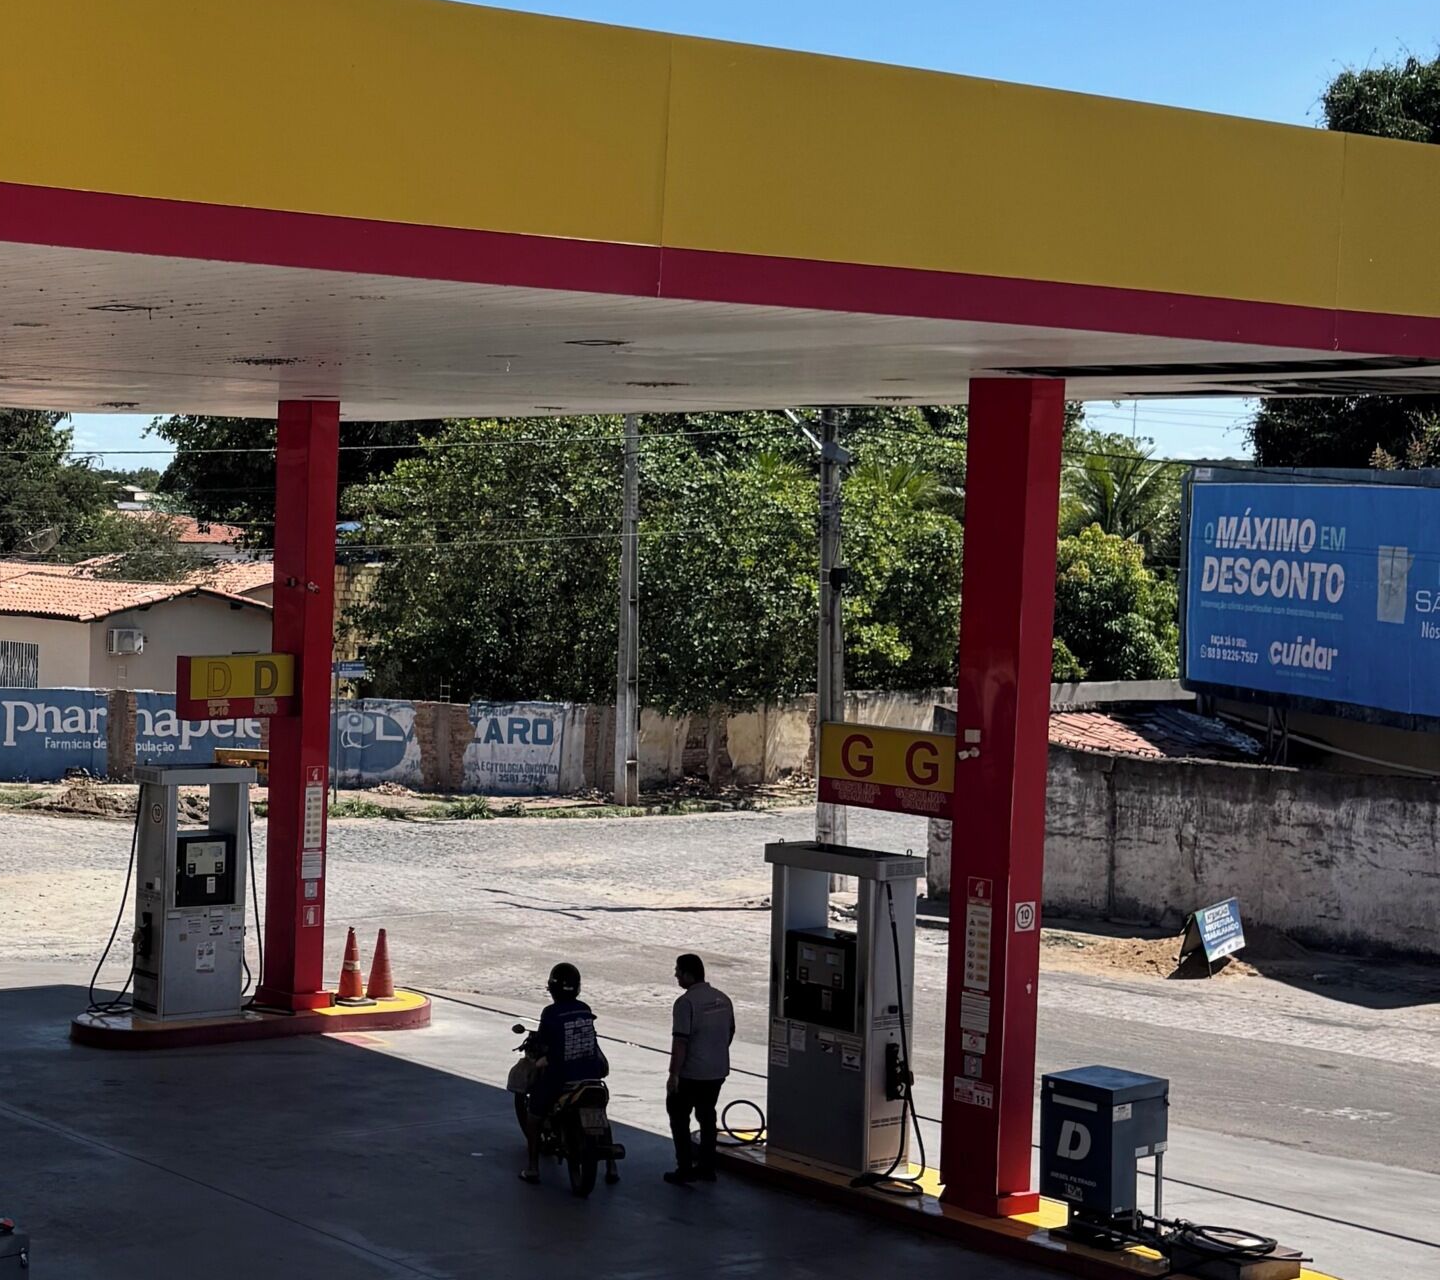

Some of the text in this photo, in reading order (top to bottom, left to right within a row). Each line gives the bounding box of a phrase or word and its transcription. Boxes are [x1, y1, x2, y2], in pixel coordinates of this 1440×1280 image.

[1204, 507, 1347, 554] O MÁXIMO EM
[1200, 555, 1346, 604] DESCONTO
[1269, 635, 1339, 671] cuidar
[207, 660, 279, 698] D D
[44, 736, 107, 751] Farmácia de
[841, 733, 940, 786] G G
[1020, 909, 1030, 921] 10
[976, 1095, 991, 1107] 151
[1056, 1119, 1092, 1161] D
